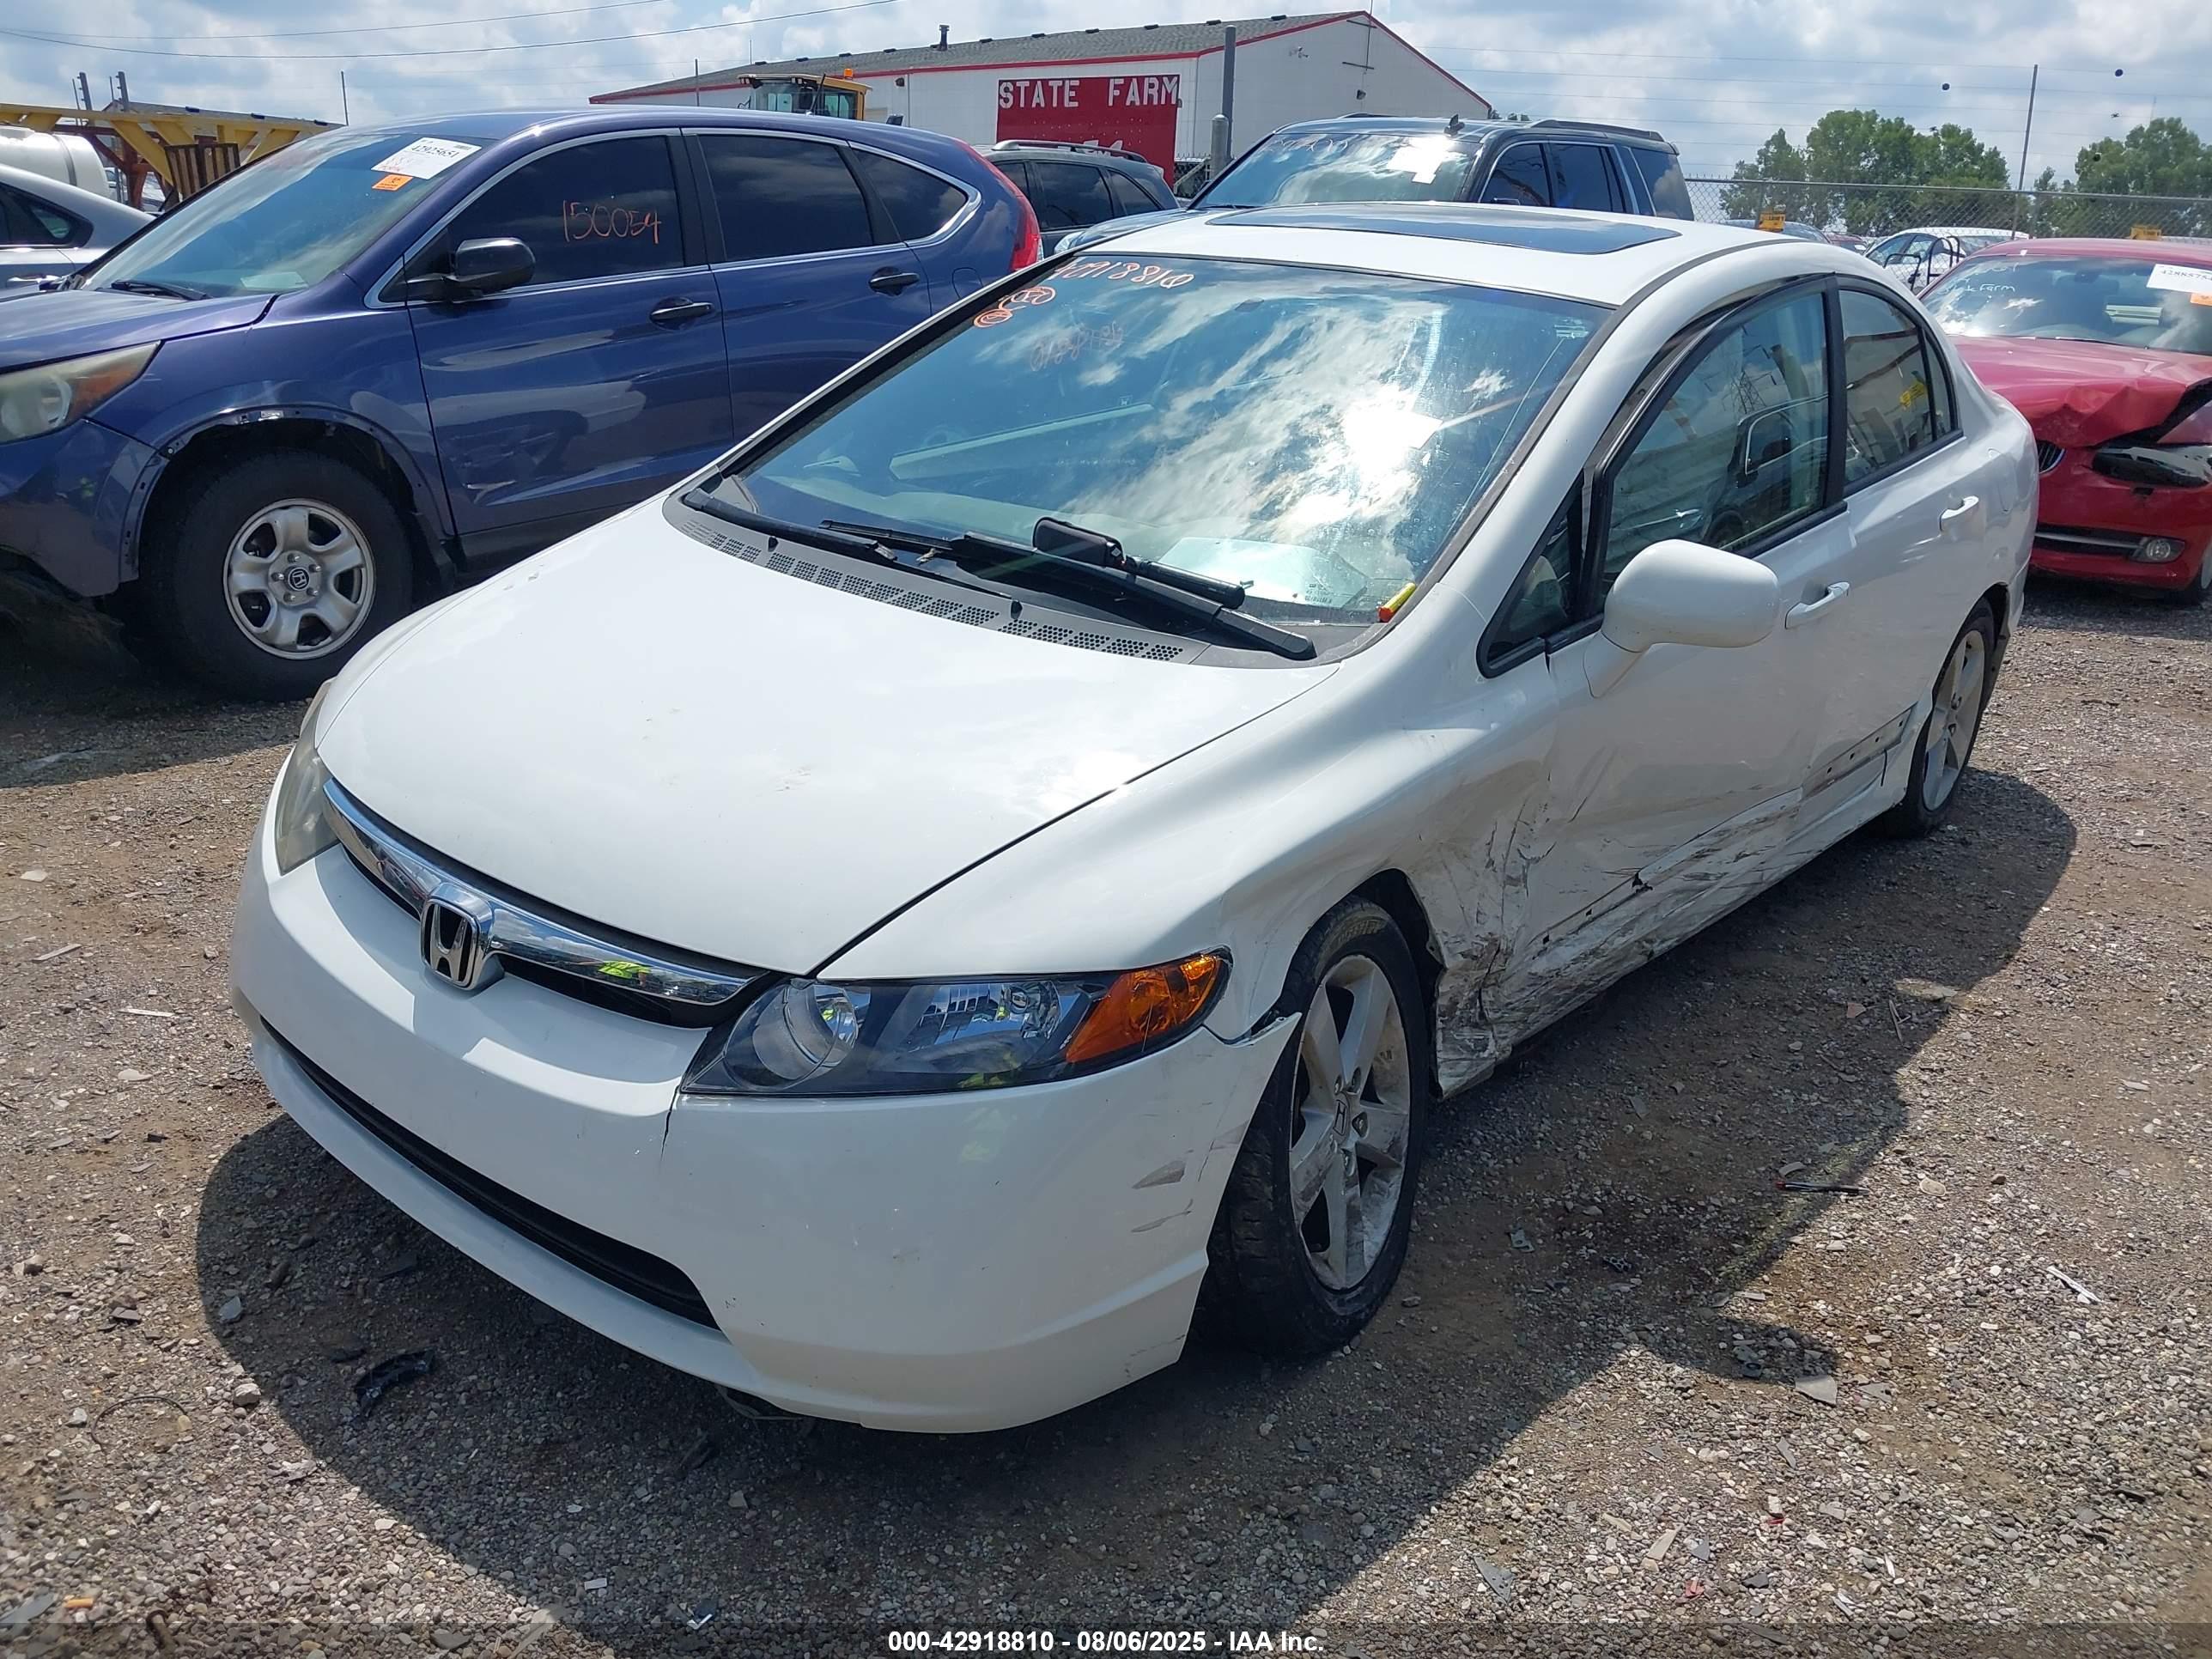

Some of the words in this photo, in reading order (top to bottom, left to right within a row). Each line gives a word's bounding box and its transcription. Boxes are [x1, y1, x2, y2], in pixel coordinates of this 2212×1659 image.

[999, 79, 1080, 109] STATE
[1108, 76, 1179, 107] FARM
[562, 199, 662, 245] 150054
